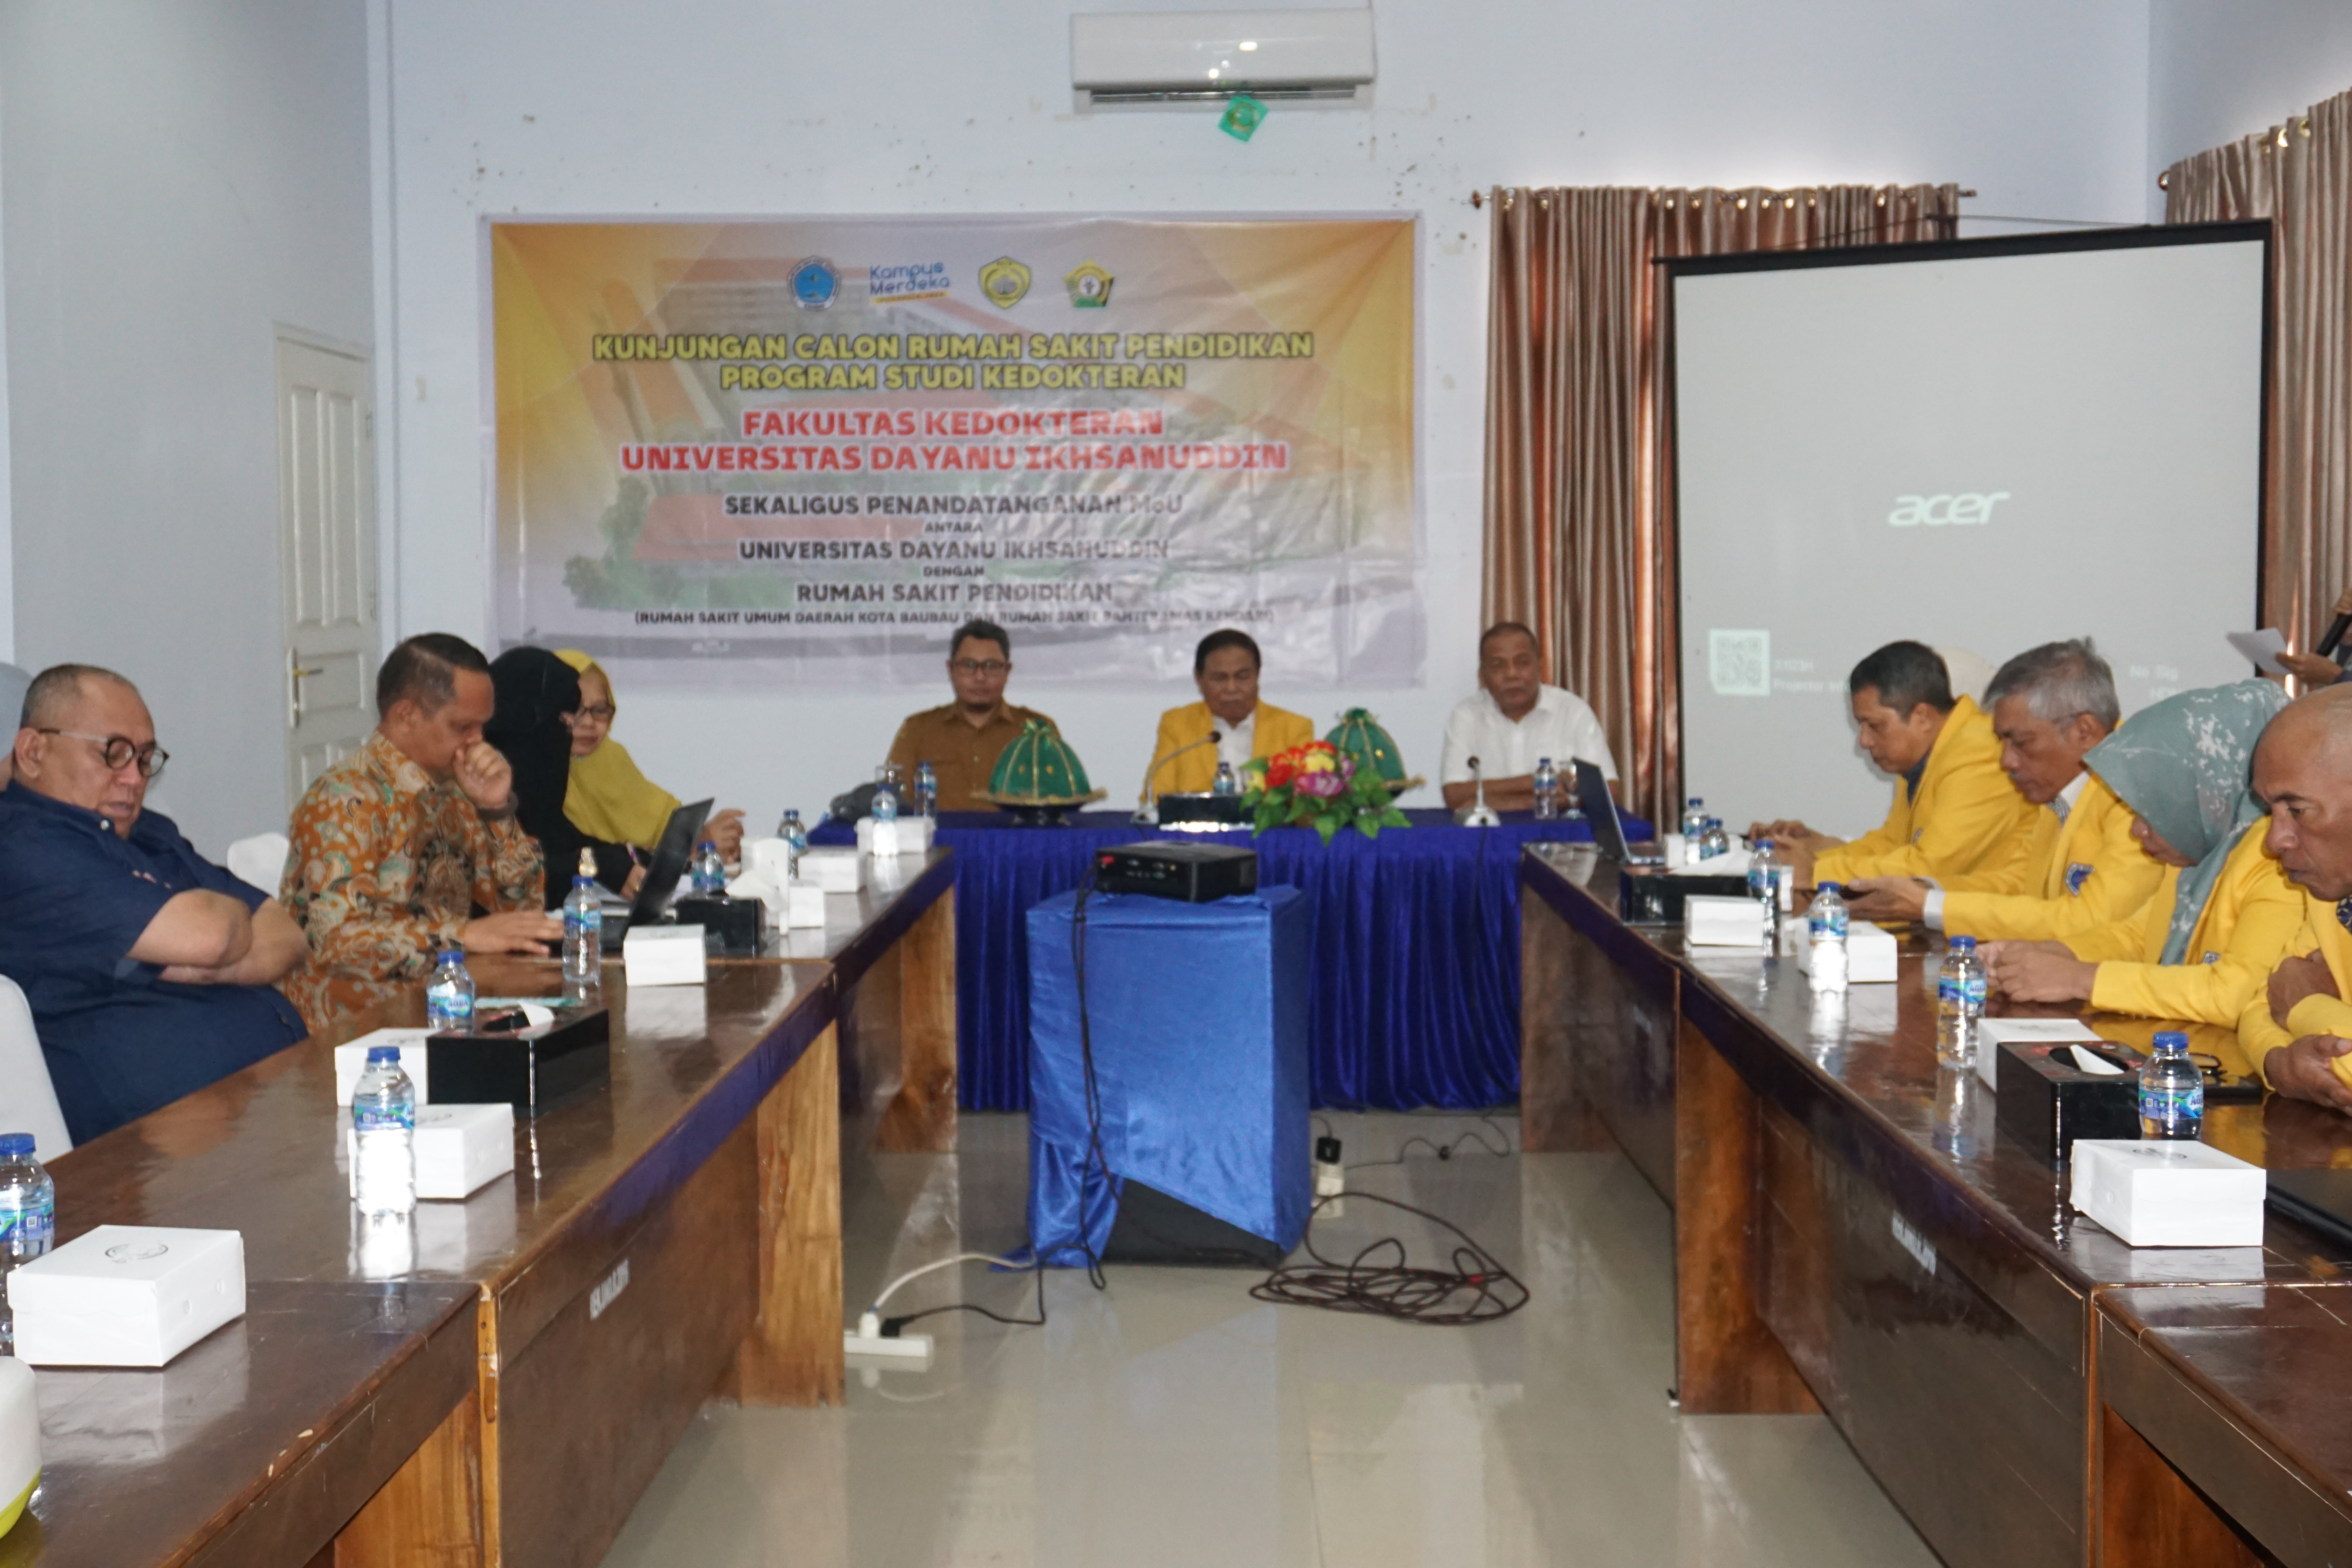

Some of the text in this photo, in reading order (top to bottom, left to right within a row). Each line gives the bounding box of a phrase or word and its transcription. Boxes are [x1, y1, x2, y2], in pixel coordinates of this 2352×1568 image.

[870, 275, 950, 295] Merdeka
[593, 332, 1314, 360] KUNJUNGAN CALON RUMAH SAKIT PENDIDIKAN
[720, 363, 1185, 389] PROGRAM STUDI KEDOKTERAN
[744, 410, 1163, 435] FAKULTAS KEDOKTERAN
[621, 444, 1286, 470] UNIVERSITAS DAYANU IKHSANUDDIN
[724, 495, 859, 515] SEKALIGUS
[867, 495, 1120, 515] PENANDATANGANAN
[1889, 492, 2011, 526] acer
[924, 522, 983, 532] ANTARA
[739, 539, 1168, 559] UNIVERSITAS DAYANU IKHSANUDDIN
[923, 566, 984, 576] DENGAN
[797, 583, 1112, 601] RUMAH SAKIT PENDIDIKAN
[635, 611, 694, 624] (RUMAH
[699, 612, 739, 623] SAKIT
[744, 612, 790, 623] UMUM
[795, 612, 854, 623] DAERAH
[859, 612, 895, 623] KOTA
[900, 612, 959, 623] BAUBAU
